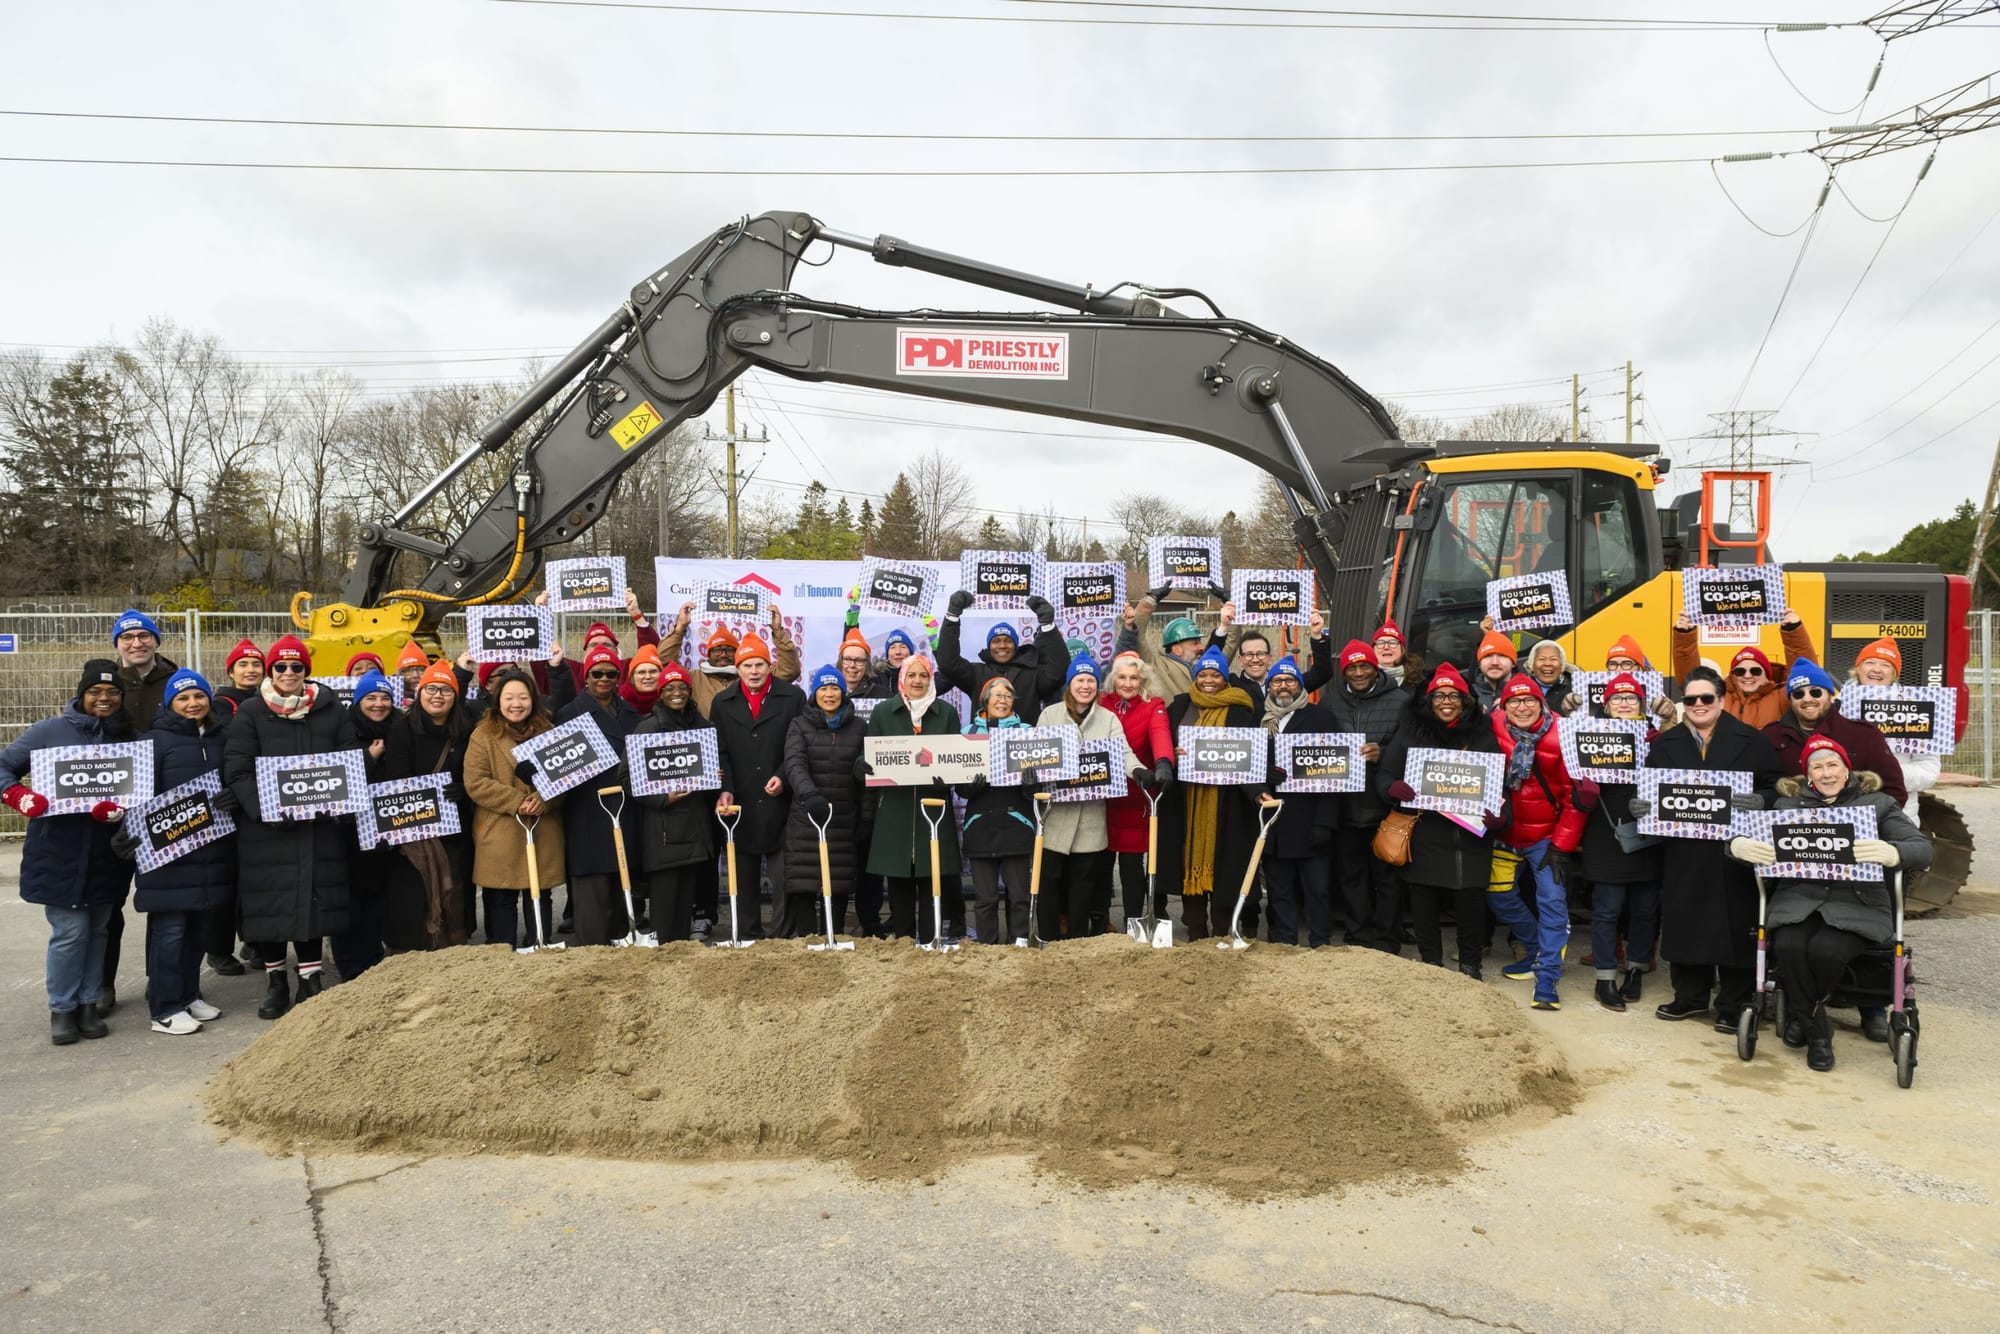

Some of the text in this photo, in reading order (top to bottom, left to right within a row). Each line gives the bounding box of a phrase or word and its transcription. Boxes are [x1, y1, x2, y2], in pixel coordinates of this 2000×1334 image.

[905, 338, 962, 368] PDI
[968, 340, 1059, 358] PRIESTLY
[968, 360, 1059, 372] DEMOLITION INC
[1167, 556, 1207, 566] CO-OPS
[563, 577, 608, 588] CO-OPS
[980, 572, 1027, 583] CO-OPS
[807, 585, 842, 597] TORONTO
[874, 579, 918, 596] CO-OP
[1066, 585, 1112, 596] CO-OPS
[1501, 589, 1539, 598] HOUSING
[1703, 584, 1749, 592] HOUSING
[709, 596, 754, 606] CO-OPS
[1250, 592, 1296, 601] CO-OPS
[1502, 593, 1550, 608] CO-OPS
[1704, 590, 1761, 602] CO-OPS
[485, 628, 535, 639] CO-OP
[1879, 625, 1924, 636] P6400H
[1865, 712, 1929, 723] CO-OPS
[558, 738, 575, 750] MORE
[1580, 744, 1632, 754] CO-OPS
[543, 742, 587, 771] CO-OP
[938, 753, 982, 764] MAISONS
[1010, 748, 1058, 760] CO-OPS
[1198, 750, 1247, 762] CO-OP
[559, 759, 584, 774] HOUSING
[648, 754, 698, 770] CO-OP
[876, 756, 910, 766] HOMES
[1296, 756, 1346, 766] CO-OPS
[312, 770, 331, 778] MORE
[1427, 764, 1471, 775] HOUSING
[59, 770, 128, 786] CO-OP
[1426, 772, 1480, 786] CO-OPS
[75, 786, 114, 794] HOUSING
[282, 777, 342, 794] CO-OP
[296, 793, 331, 802] HOUSING
[377, 794, 422, 807] HOUSING
[1662, 796, 1726, 811] CO-OP
[150, 799, 194, 824] HOUSING
[378, 799, 434, 818] CO-OPS
[151, 802, 207, 834] CO-OPS
[1675, 812, 1712, 820] HOUSING
[1778, 836, 1850, 850] CO-OP
[1795, 852, 1836, 860] HOUSING
